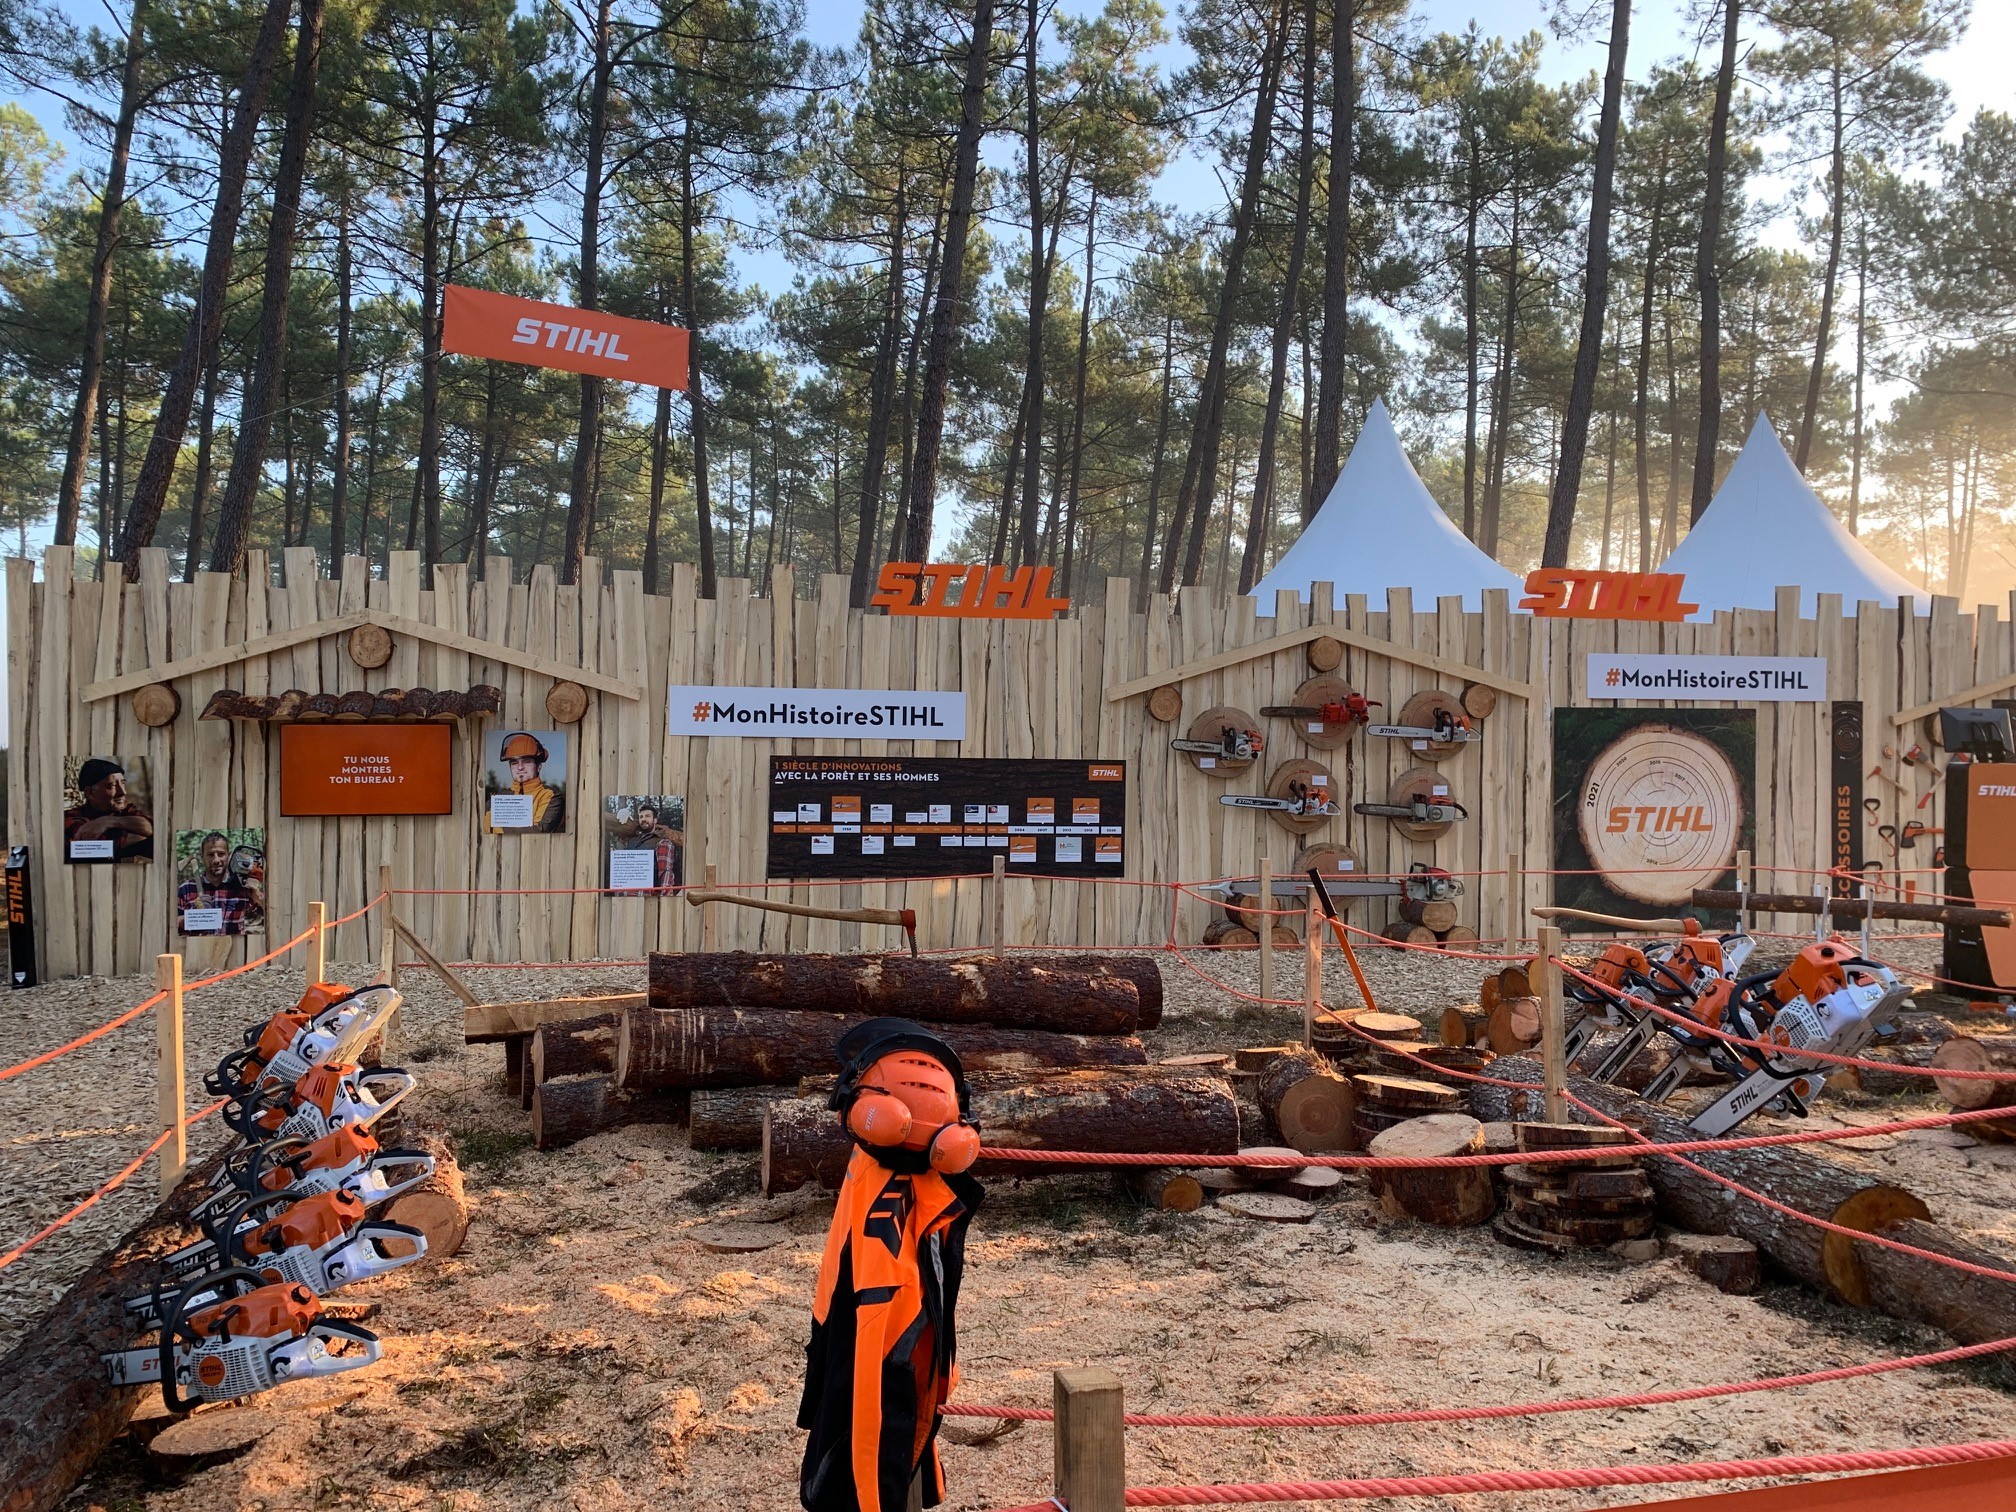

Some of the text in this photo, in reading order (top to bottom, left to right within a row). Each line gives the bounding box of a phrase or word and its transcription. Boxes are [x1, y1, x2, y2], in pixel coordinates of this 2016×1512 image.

[512, 318, 629, 361] STIHL
[871, 562, 1070, 617] STIHL
[1518, 568, 1699, 621] STIHL
[1606, 667, 1809, 690] #MonHistoireSTIHL
[693, 701, 944, 727] #MonHistoireSTIHL
[1379, 727, 1401, 735] STIHL
[341, 766, 392, 774] MONTRES
[343, 756, 390, 764] TU NOUS
[774, 761, 779, 770] 1
[782, 760, 819, 770] SIÈCLE
[329, 776, 351, 784] TON
[354, 776, 396, 784] BUREAU
[774, 770, 940, 782] AVEC LA FORÊT ET SES HOMMES
[1092, 769, 1119, 777] STIHL
[1586, 782, 1601, 808] 2021
[1978, 784, 2016, 797] STIHL
[1605, 806, 1713, 833] STIHL
[8, 870, 25, 925] STIHL
[1730, 1086, 1759, 1115] STIHL
[864, 1106, 876, 1132] STIHL
[200, 1365, 223, 1374] STIHL
